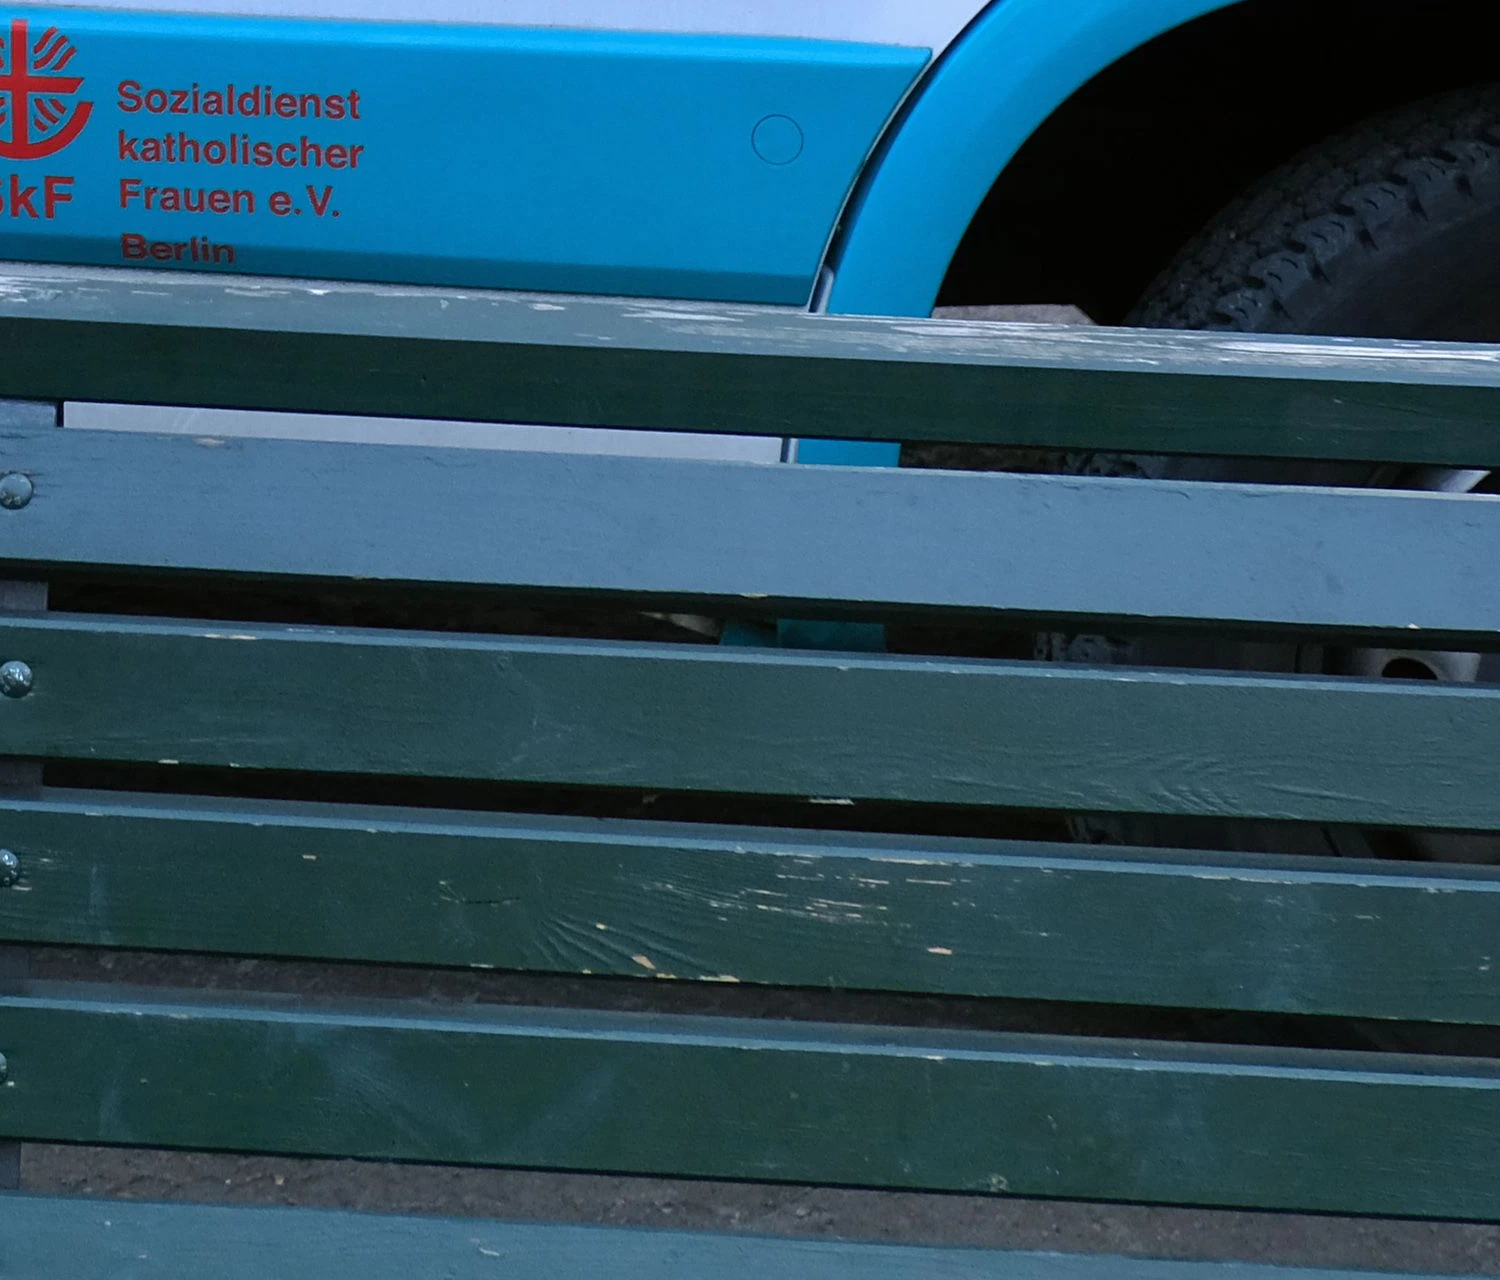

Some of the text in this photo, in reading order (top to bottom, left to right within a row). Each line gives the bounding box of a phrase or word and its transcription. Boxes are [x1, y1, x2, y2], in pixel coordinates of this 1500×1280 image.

[116, 80, 361, 120] Sozialdienst
[117, 128, 365, 169] katholischer
[119, 177, 340, 217] Frauen e.V.
[120, 232, 236, 264] Berlin
